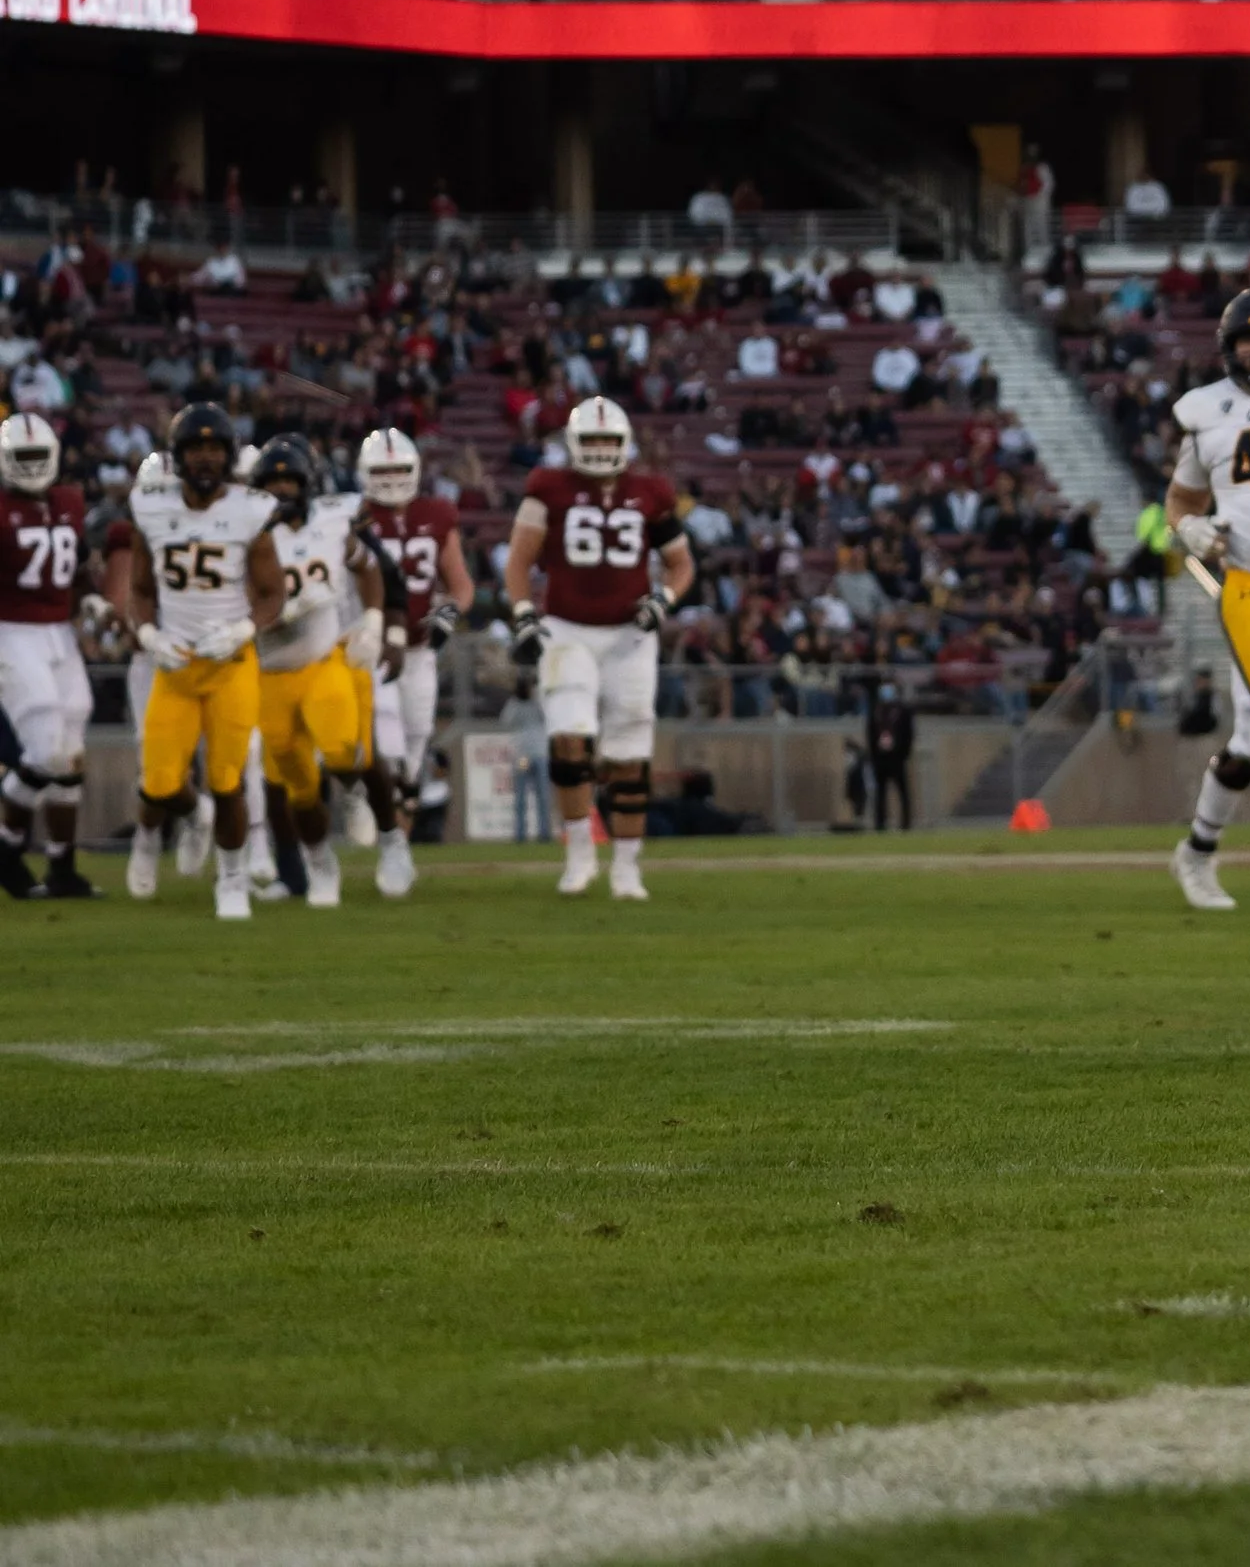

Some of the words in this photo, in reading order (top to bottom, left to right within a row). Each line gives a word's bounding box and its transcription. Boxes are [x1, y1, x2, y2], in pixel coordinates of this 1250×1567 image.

[17, 526, 77, 588] 78
[163, 542, 225, 591] 55
[564, 505, 644, 568] 63
